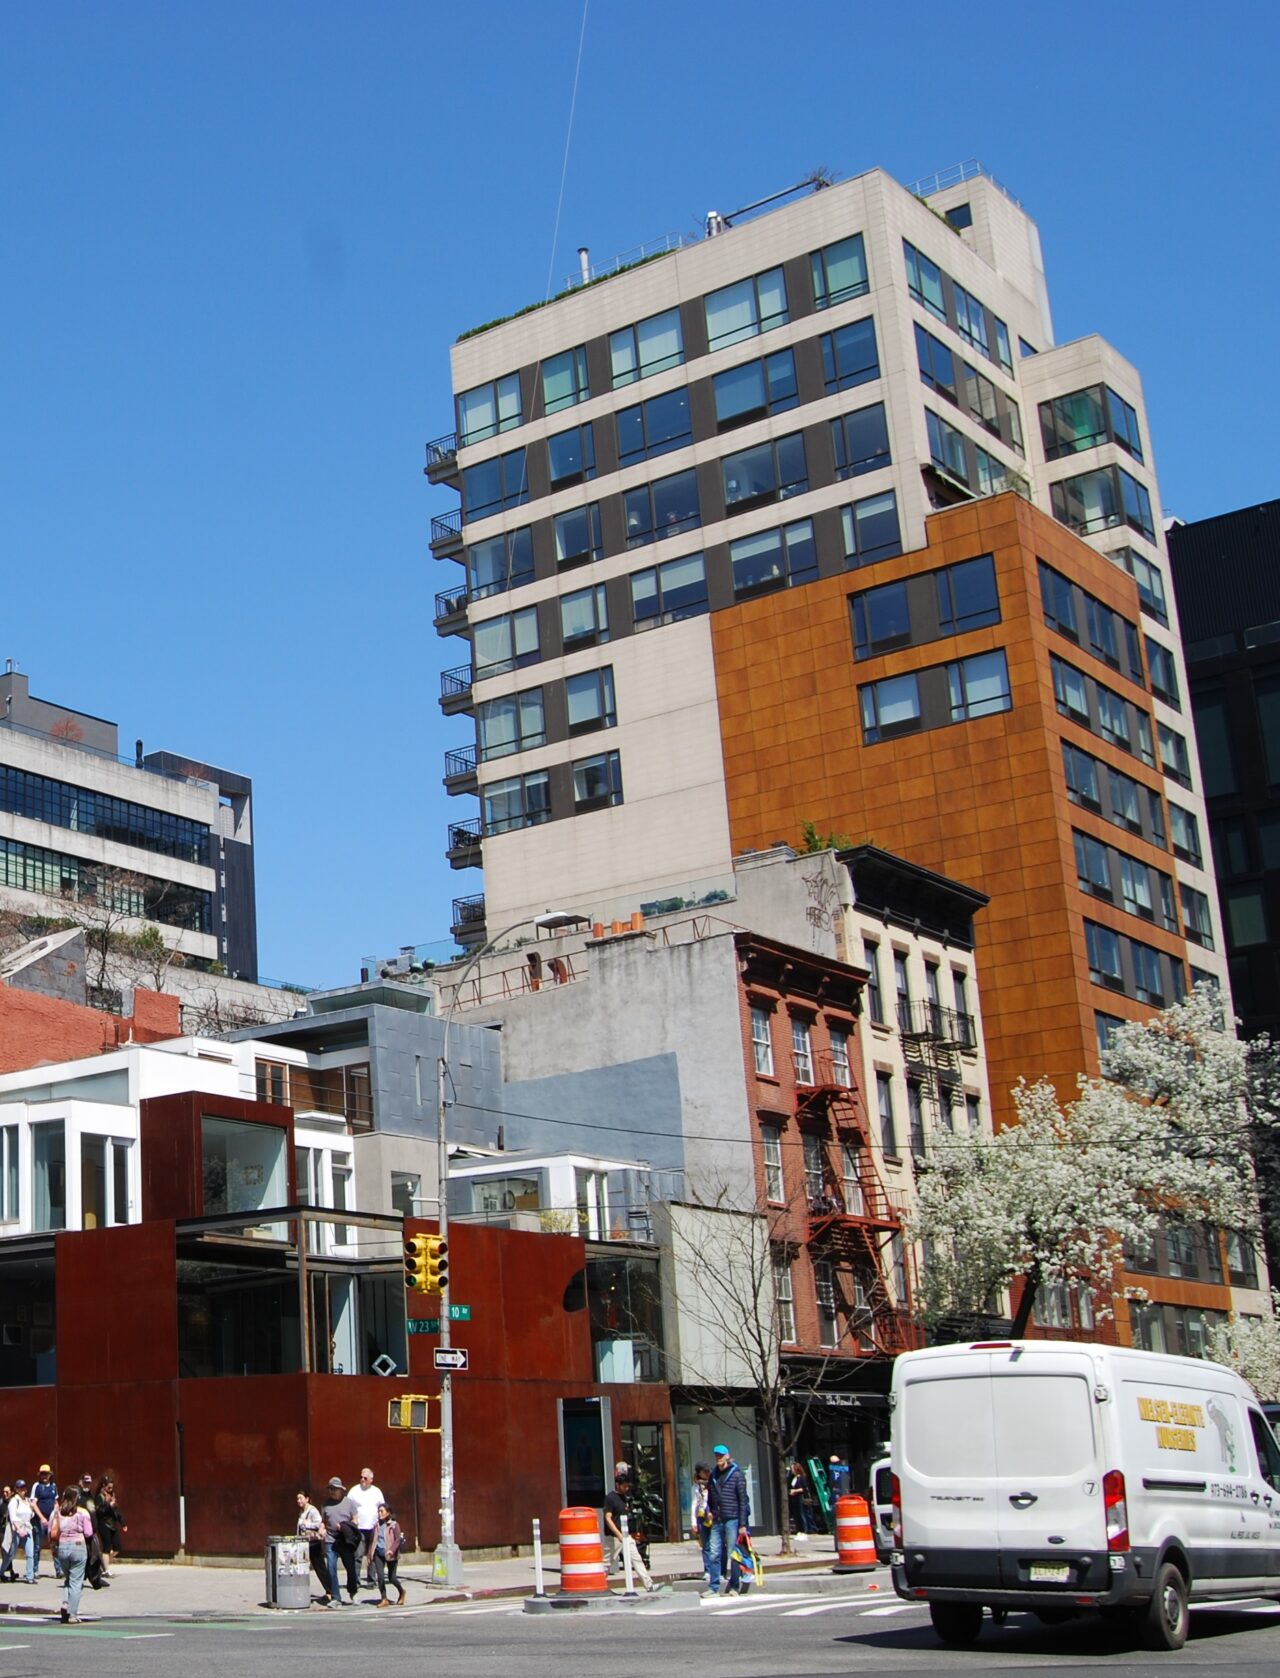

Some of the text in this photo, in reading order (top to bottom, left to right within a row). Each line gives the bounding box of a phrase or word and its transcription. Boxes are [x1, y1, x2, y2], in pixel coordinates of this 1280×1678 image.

[451, 1306, 460, 1318] 10
[419, 1320, 430, 1333] 23
[1087, 1482, 1095, 1494] 7
